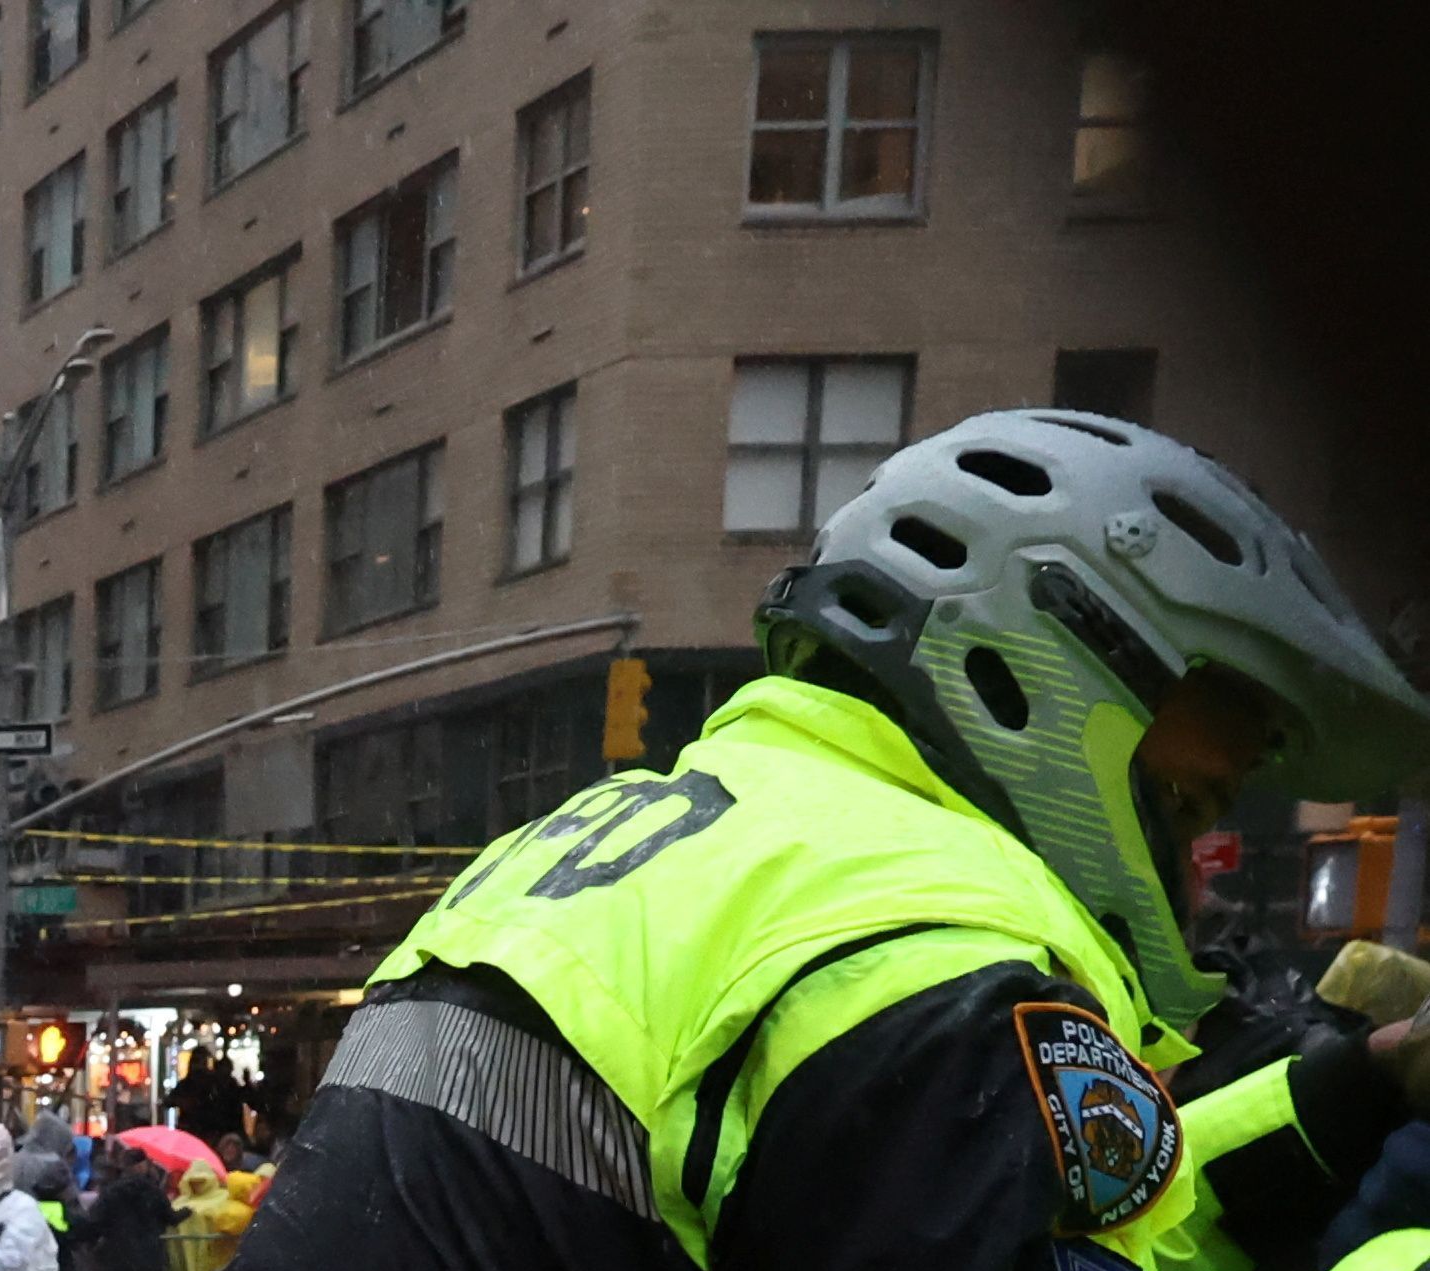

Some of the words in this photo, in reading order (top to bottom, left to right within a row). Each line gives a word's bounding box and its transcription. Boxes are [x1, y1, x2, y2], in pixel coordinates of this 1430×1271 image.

[1047, 1093, 1077, 1157] CITY
[1067, 1165, 1086, 1201] OF
[1101, 1183, 1148, 1226] NEW
[1146, 1120, 1176, 1184] YORK
